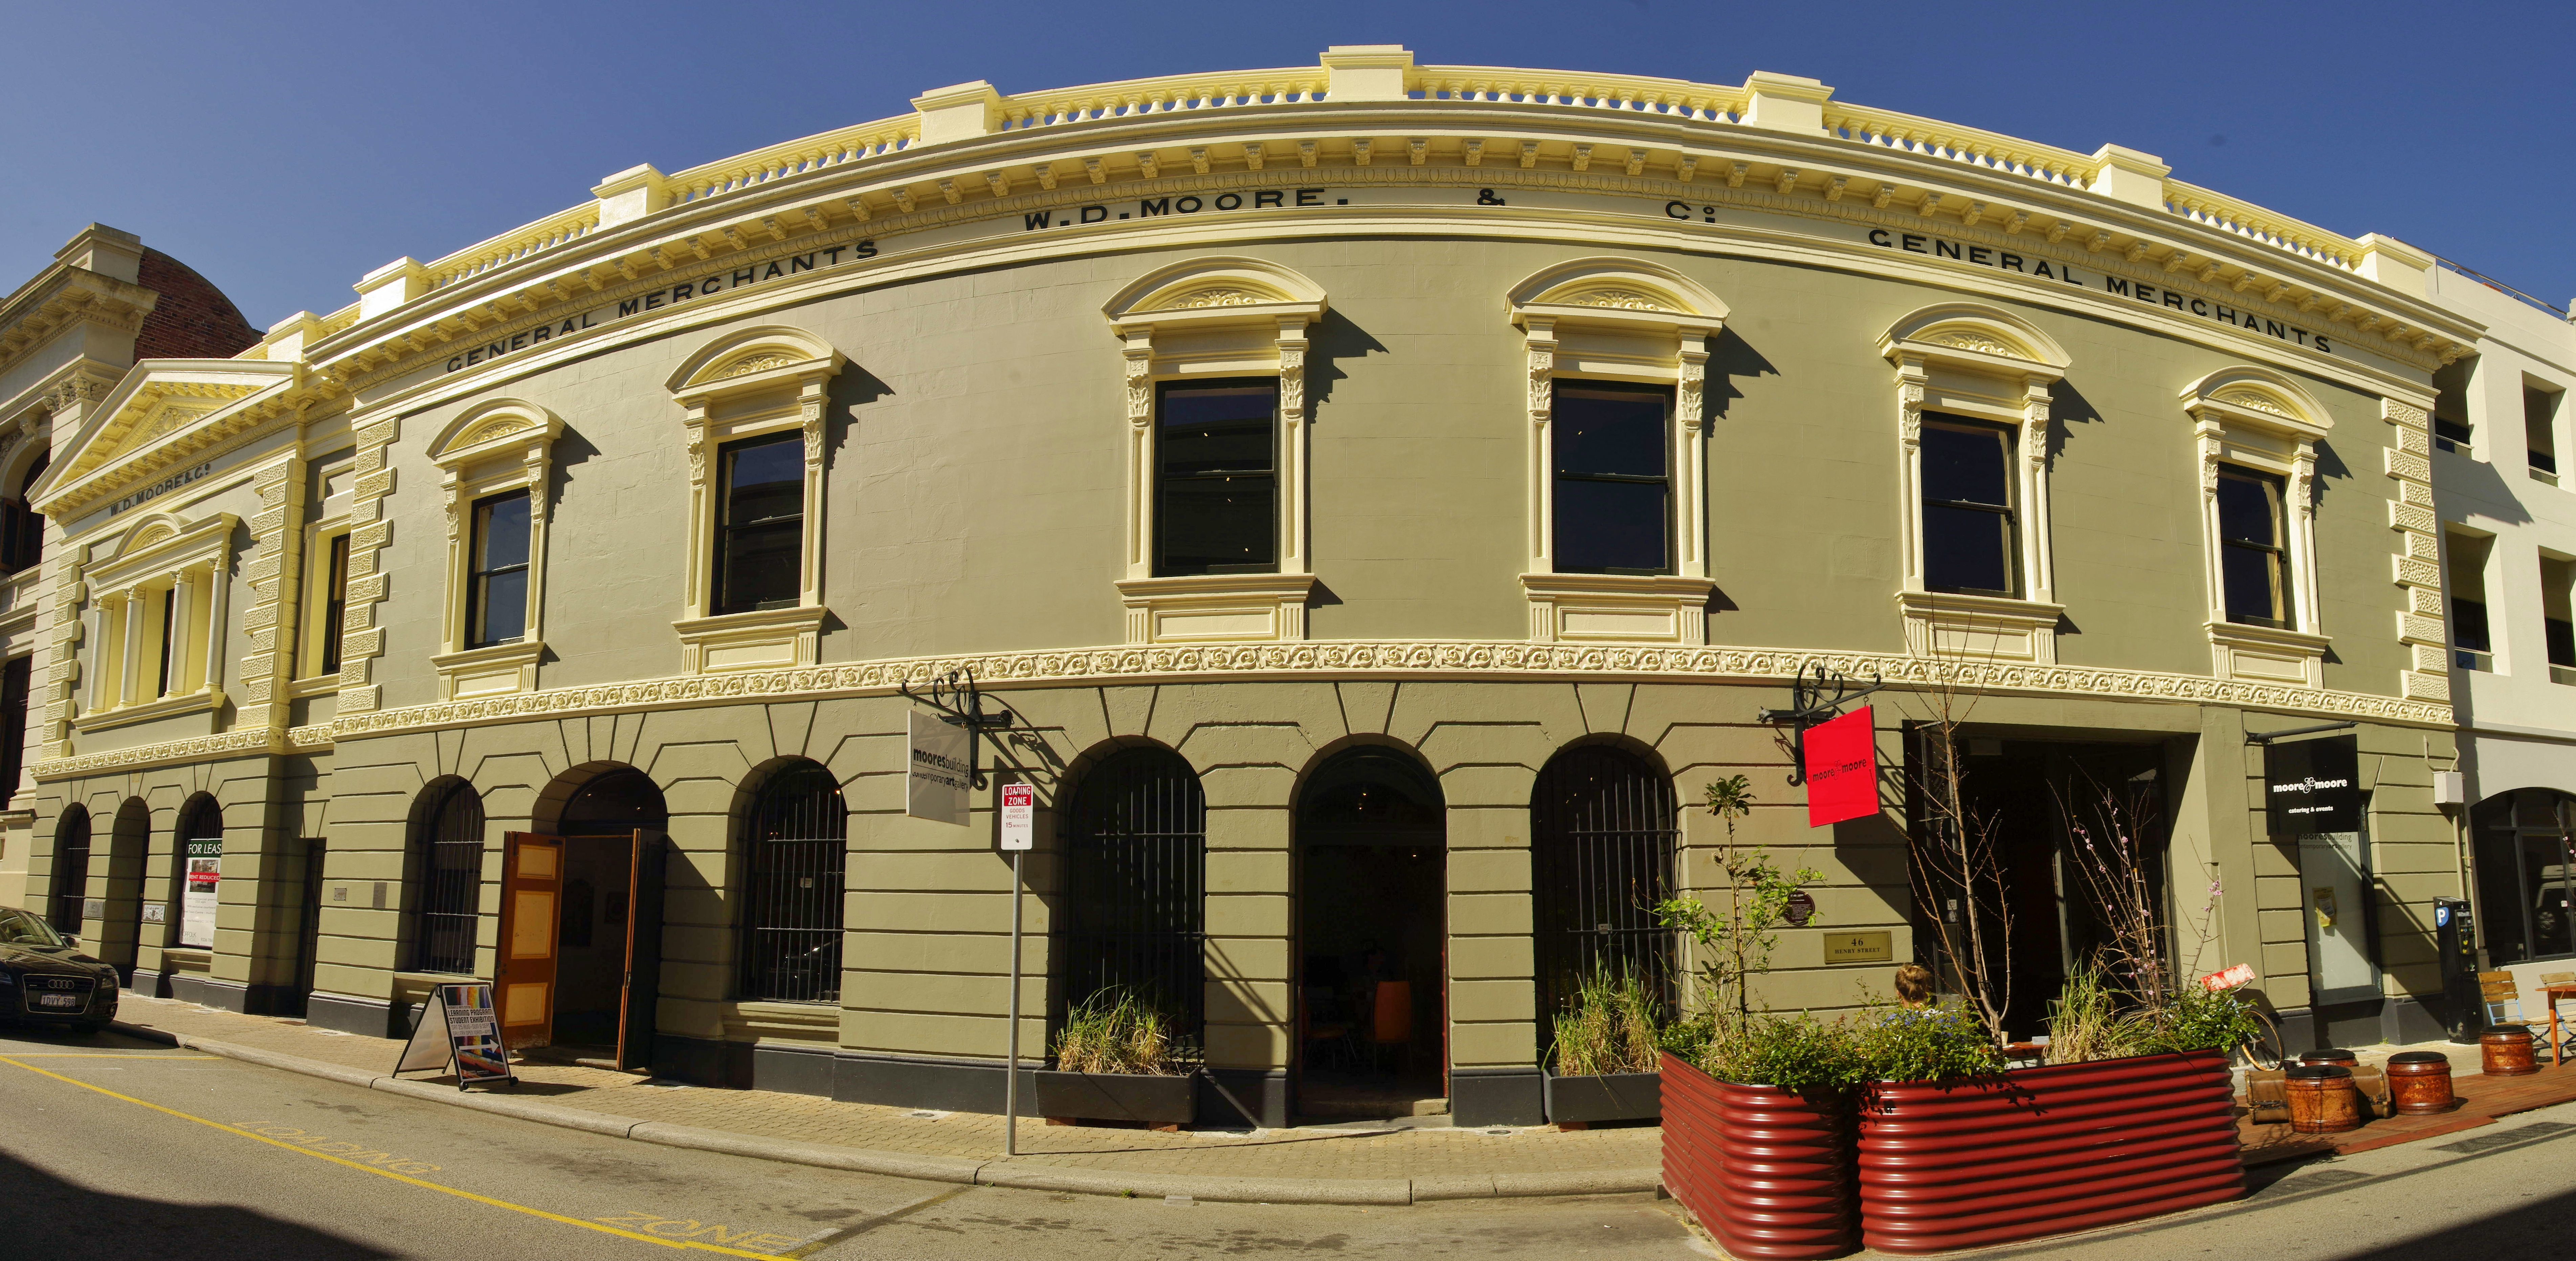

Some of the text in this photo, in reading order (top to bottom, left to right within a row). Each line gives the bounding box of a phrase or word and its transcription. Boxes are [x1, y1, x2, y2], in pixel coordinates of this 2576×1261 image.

[1477, 189, 1505, 205] &
[1868, 230, 2331, 353] GENERAL MERCHANTS
[447, 242, 878, 373] GENERAL MERCHANTS
[913, 748, 969, 777] mooresbuilding
[1005, 786, 1030, 796] LOADING
[1008, 797, 1027, 805] ZONE
[188, 844, 222, 854] FOR LEAS
[2437, 909, 2446, 923] P
[1851, 938, 1863, 946] 46
[232, 1121, 441, 1174] LOADING
[593, 1211, 804, 1252] ZONE
